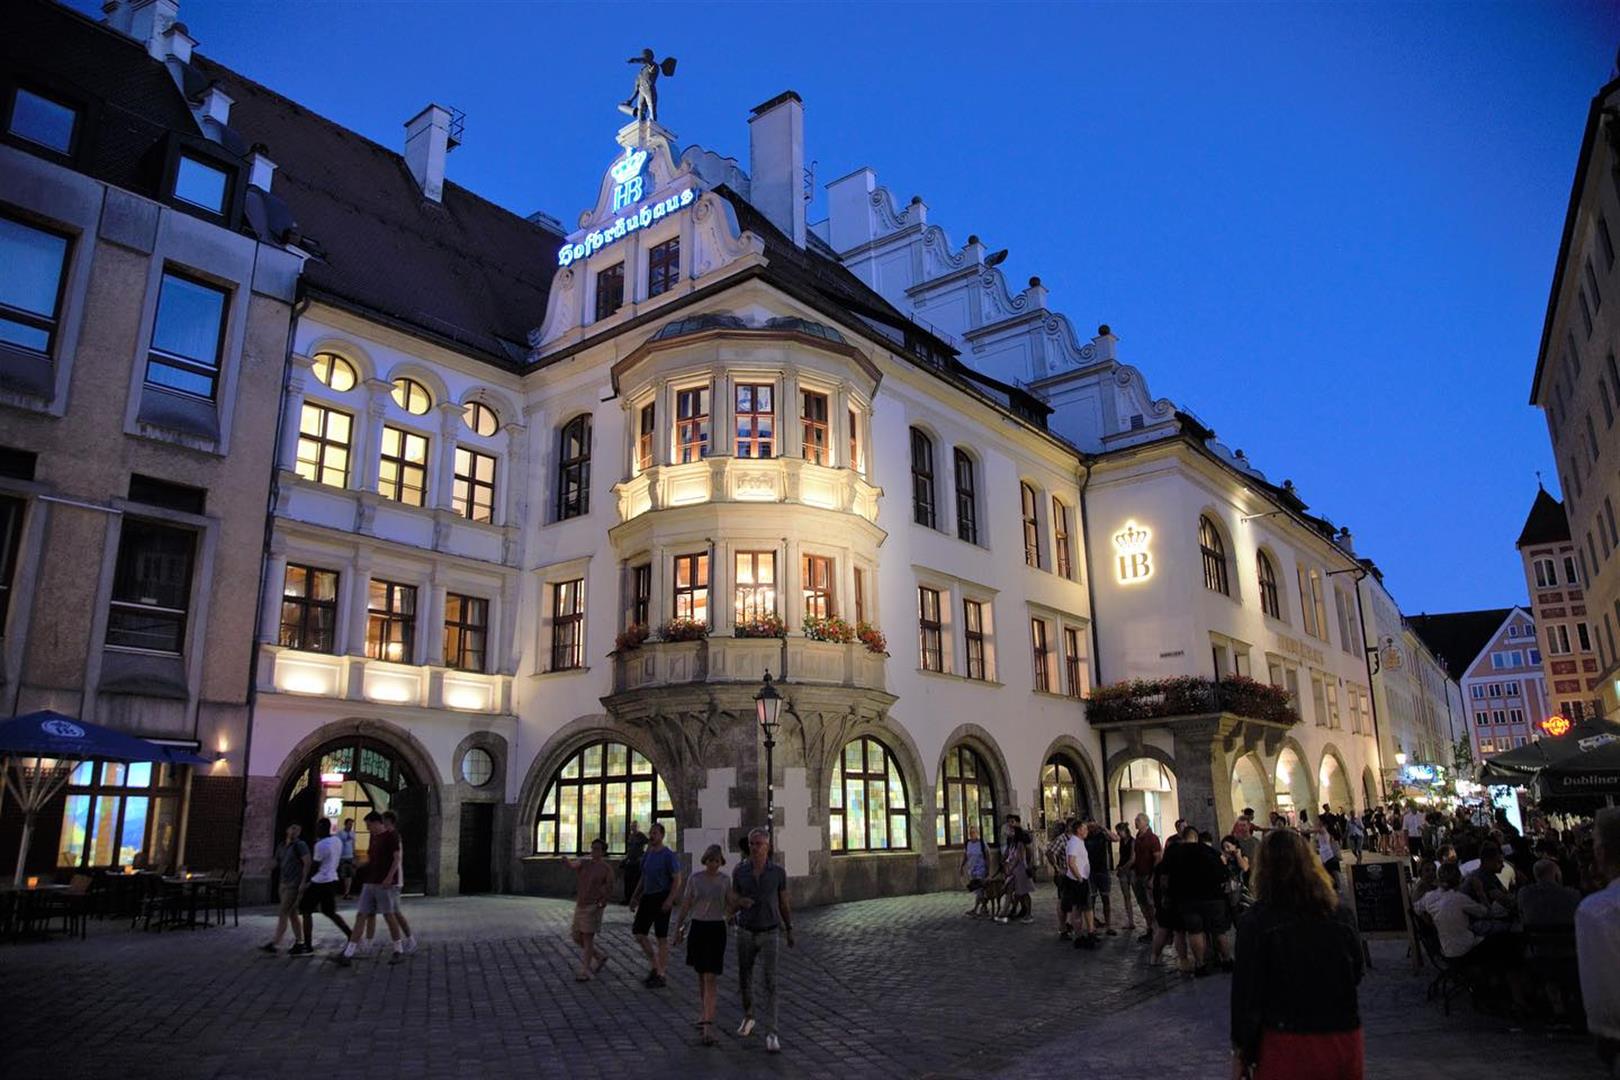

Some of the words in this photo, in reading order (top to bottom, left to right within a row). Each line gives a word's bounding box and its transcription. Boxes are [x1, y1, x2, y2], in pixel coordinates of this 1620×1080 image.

[612, 176, 643, 214] HB
[558, 188, 694, 266] Hofbräuhaus
[1117, 551, 1152, 581] HB
